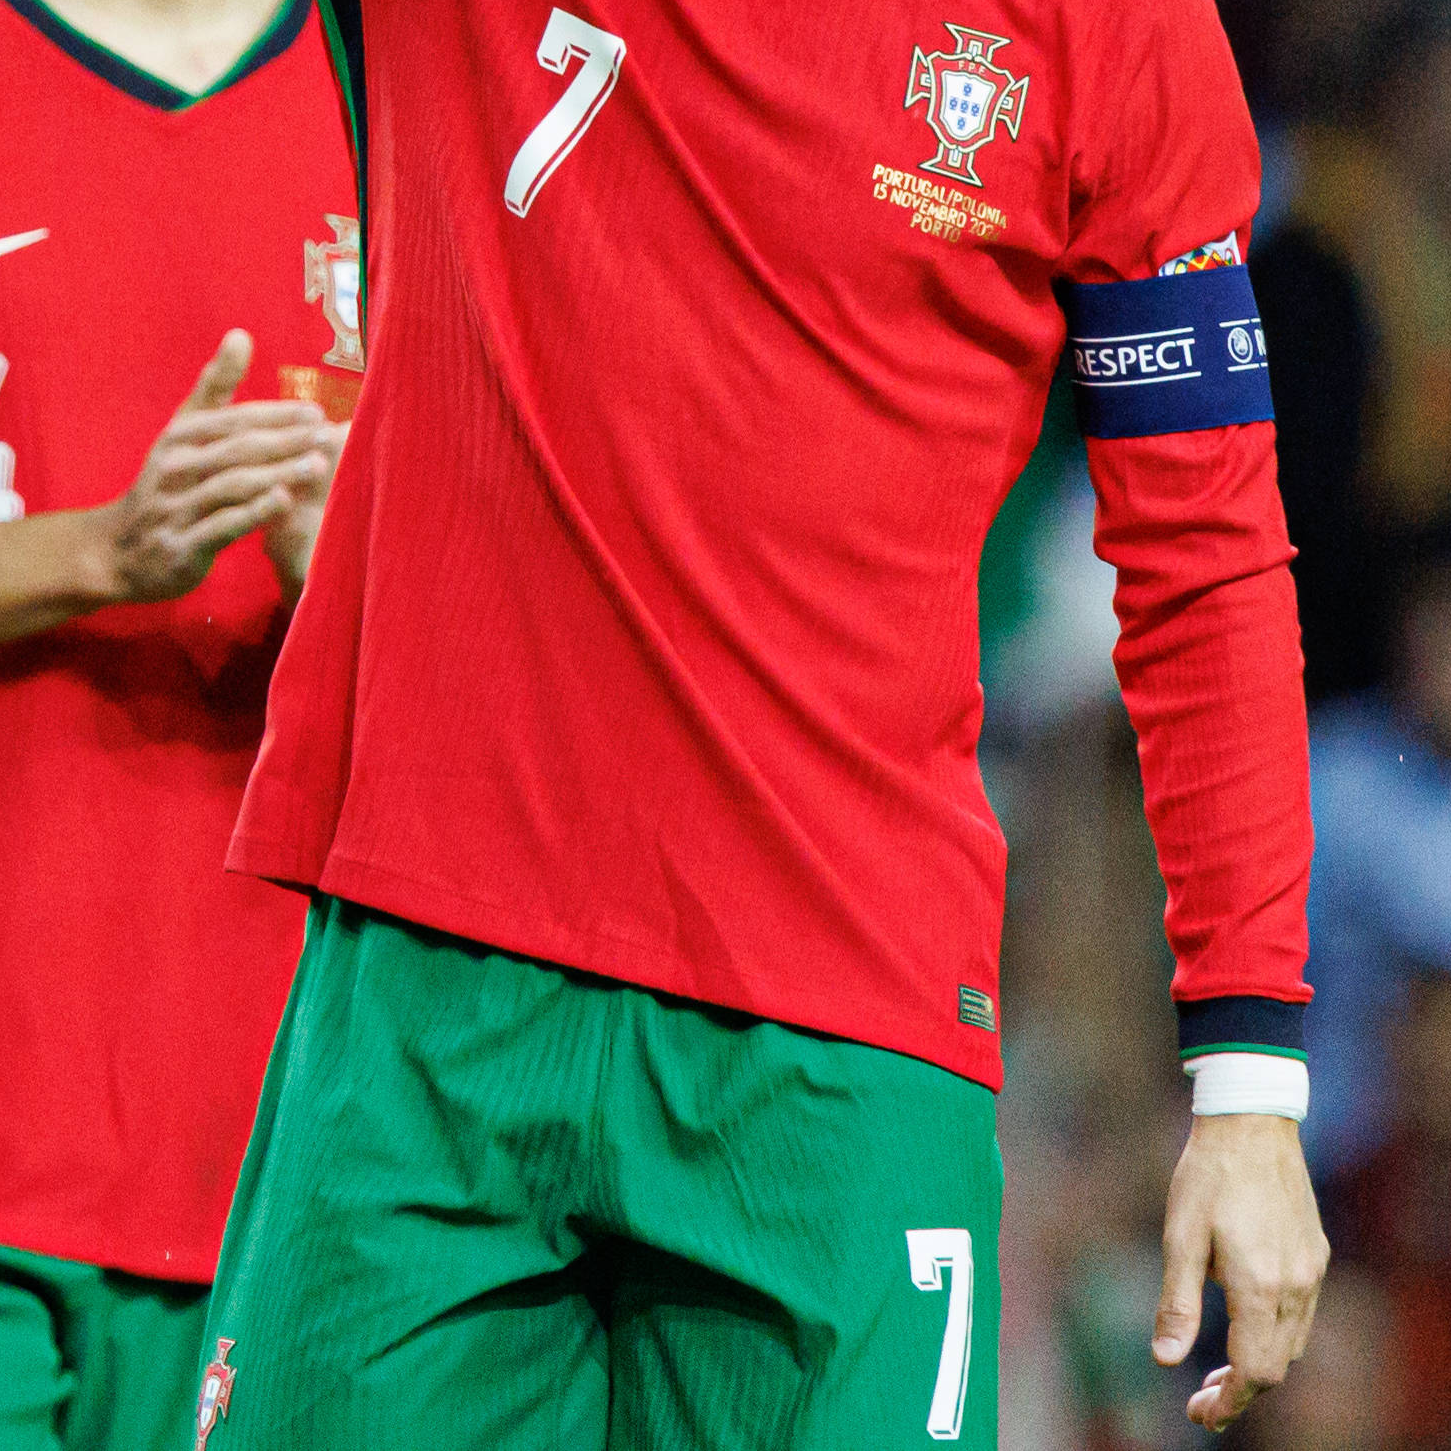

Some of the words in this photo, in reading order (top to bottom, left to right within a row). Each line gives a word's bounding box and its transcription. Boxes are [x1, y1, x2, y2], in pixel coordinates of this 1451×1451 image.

[504, 7, 626, 218] 7
[873, 182, 888, 200] 15
[890, 188, 967, 229] NOVEMBRO
[909, 212, 961, 243] PORTO
[1073, 337, 1196, 377] RESPECT
[905, 1228, 974, 1440] 7
